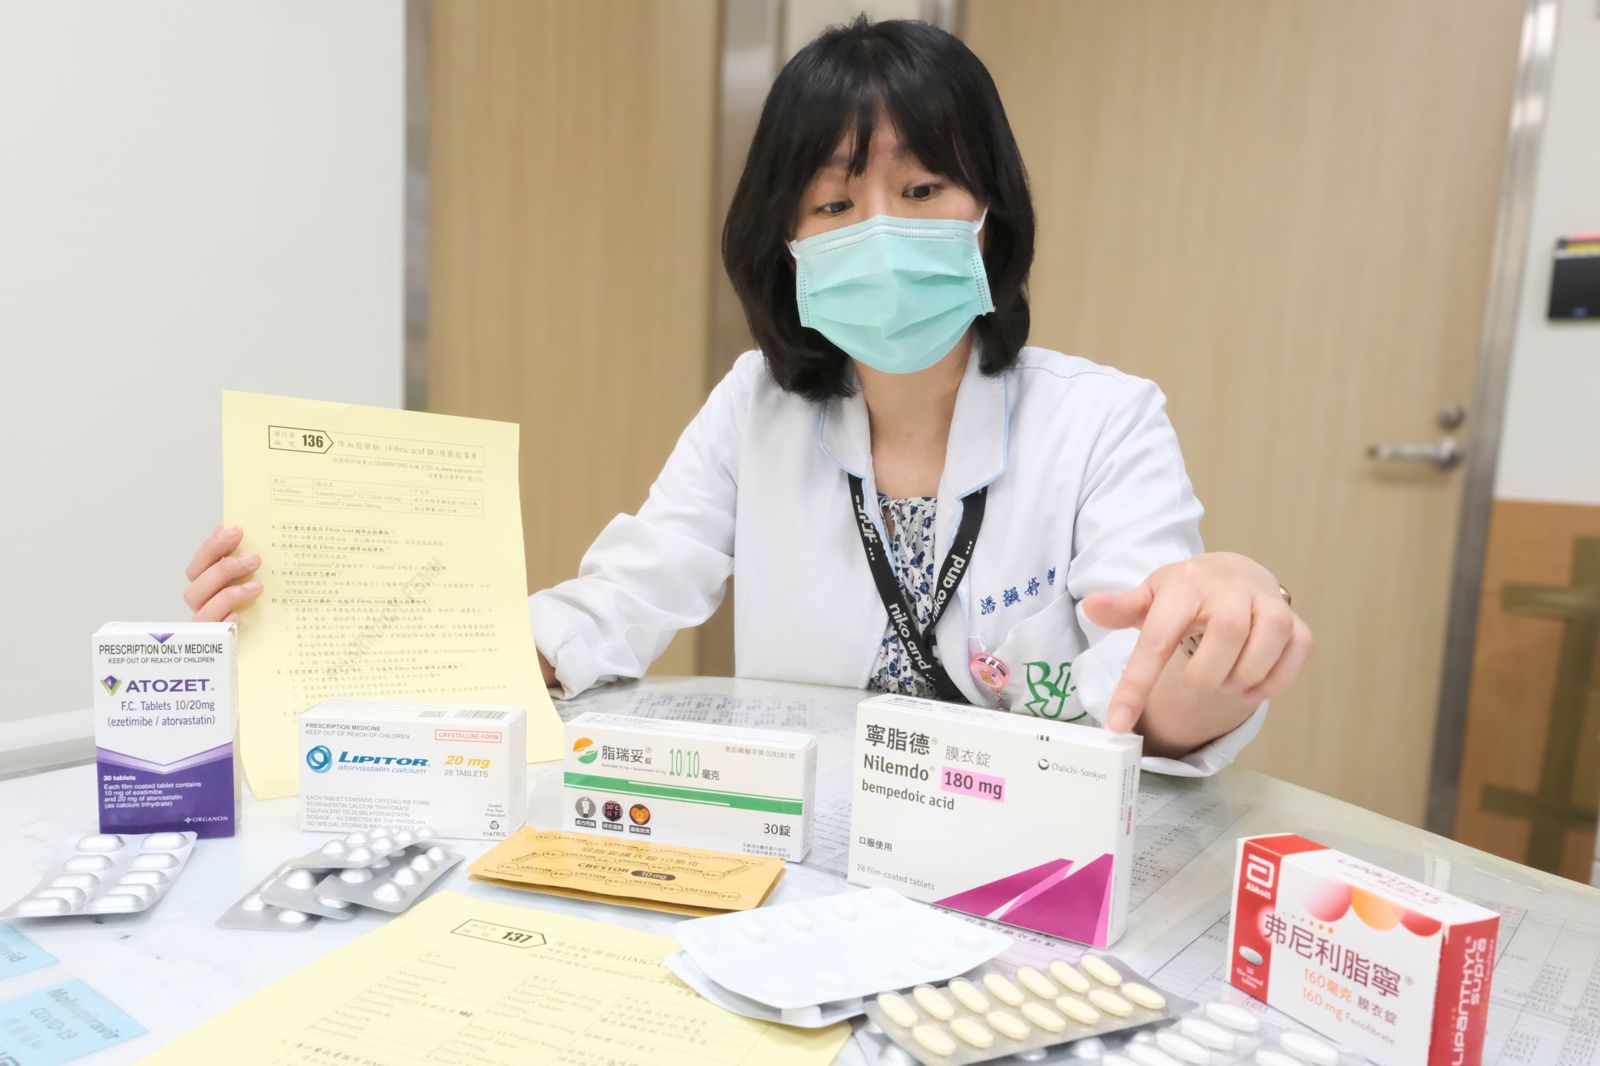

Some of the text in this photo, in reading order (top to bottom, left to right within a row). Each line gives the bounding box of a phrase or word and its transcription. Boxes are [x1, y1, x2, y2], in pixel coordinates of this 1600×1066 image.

[302, 434, 324, 448] 136
[943, 554, 965, 587] and
[889, 603, 931, 670] niko and
[99, 644, 223, 655] PRESCRIPTION ONLY MEDICINE
[126, 679, 210, 693] ATOZET
[121, 701, 215, 711] F.C. Tablets 10/20mg
[108, 717, 153, 727] (ezetimibe
[162, 715, 215, 726] atorvastatin)
[865, 724, 991, 768] 寧脂德 膜衣錠
[445, 755, 491, 769] 20 mg
[602, 745, 644, 764] 脂瑞妥
[338, 765, 389, 773] atorvastatin
[702, 769, 720, 780] 毫克
[863, 754, 929, 781] Nilemdo
[945, 771, 1002, 800] 180 mg
[862, 779, 955, 810] bempedoic acid
[764, 823, 791, 837] 30錠
[858, 836, 893, 852] 口服使用
[578, 862, 630, 874] CRESTOR
[856, 863, 866, 874] 28
[909, 877, 935, 891] tablets
[1245, 883, 1272, 900] Abbott
[501, 931, 534, 943] 137
[1263, 913, 1401, 998] 弗尼利脂寧
[1302, 988, 1322, 1006] 160
[1325, 1002, 1344, 1023] mg
